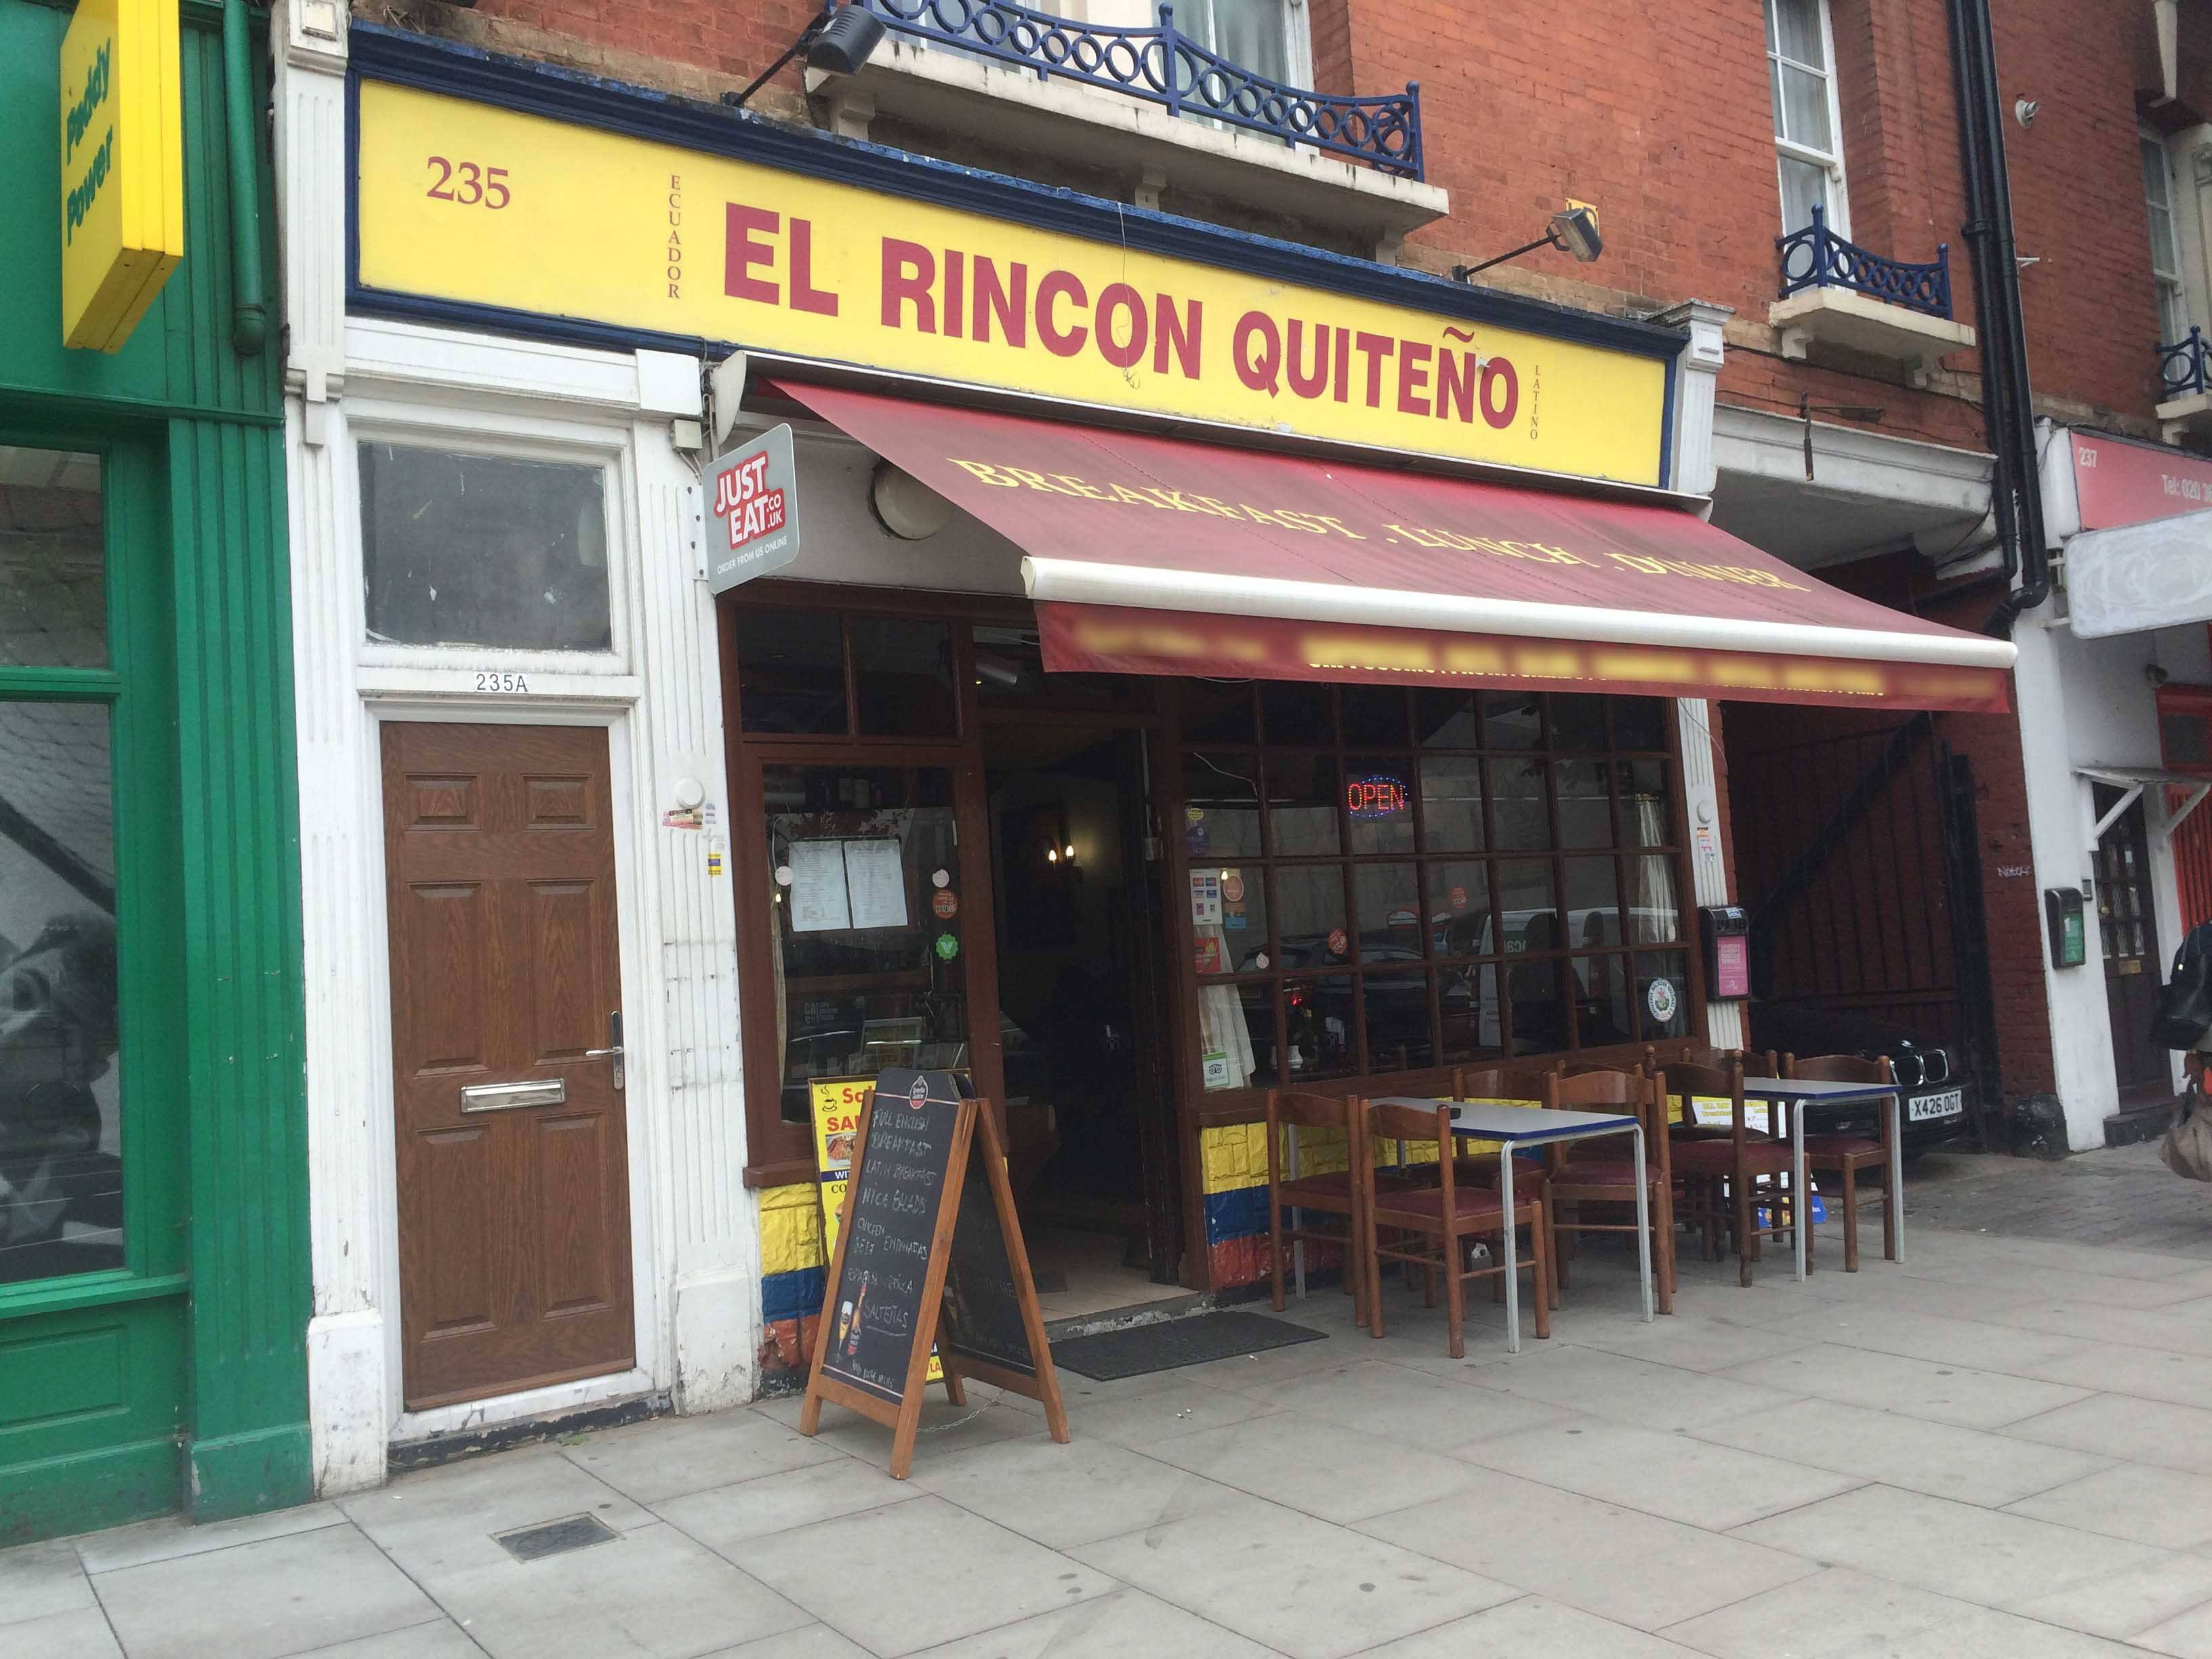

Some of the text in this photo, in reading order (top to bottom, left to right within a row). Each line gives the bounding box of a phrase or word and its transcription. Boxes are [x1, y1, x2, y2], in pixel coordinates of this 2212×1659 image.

[66, 37, 110, 165] Paddy
[66, 124, 113, 247] Power
[426, 156, 510, 209] 235
[668, 173, 681, 300] ECUADOR
[724, 201, 1519, 430] EL RINCON QUITEÑO
[1530, 364, 1540, 441] LATINO
[716, 456, 766, 512] JUST
[2079, 447, 2097, 468] 237
[730, 494, 769, 545] EAT
[946, 457, 1367, 539] BREAKFAST
[717, 535, 788, 575] ORDER FROM US ONLINE
[476, 674, 528, 692] 235A
[1347, 782, 1404, 811] OPEN
[1914, 1093, 1959, 1117] X426 OGT
